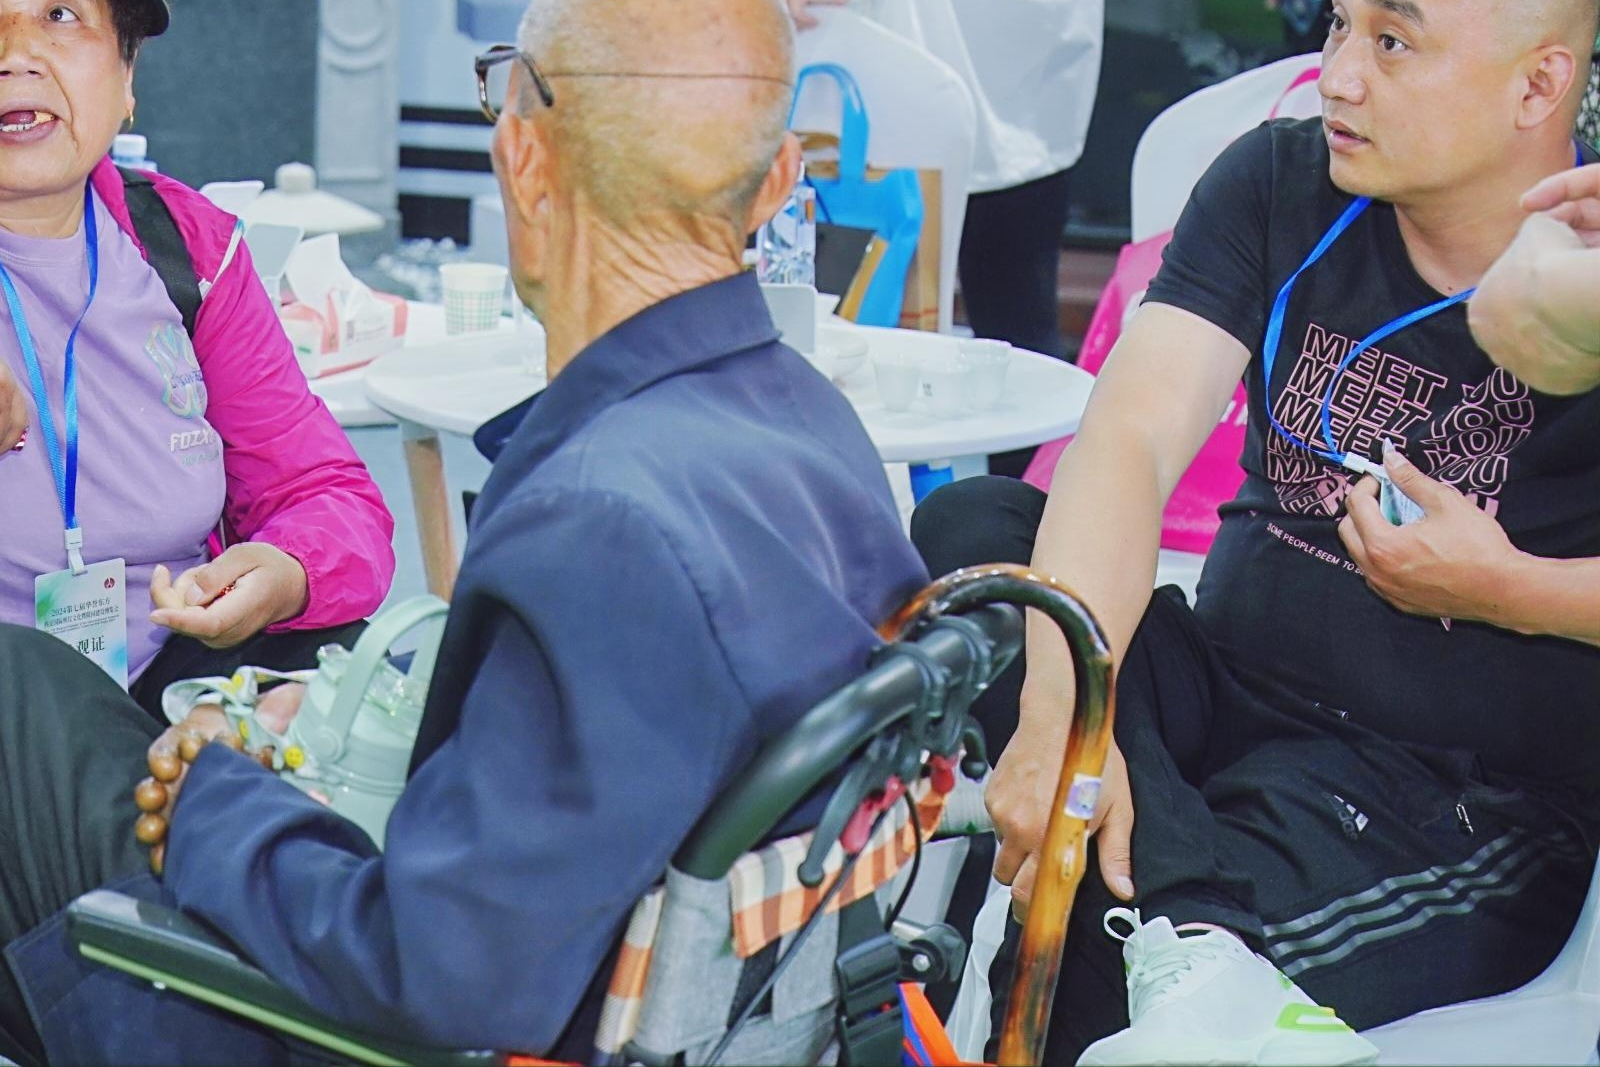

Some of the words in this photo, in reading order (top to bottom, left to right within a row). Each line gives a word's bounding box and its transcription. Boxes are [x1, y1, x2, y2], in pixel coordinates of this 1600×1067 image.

[1286, 353, 1433, 435] MEET
[1302, 322, 1449, 408] MEET
[1282, 532, 1317, 556] PEOPLE
[1314, 548, 1341, 566] SEEM
[1342, 559, 1356, 572] TO
